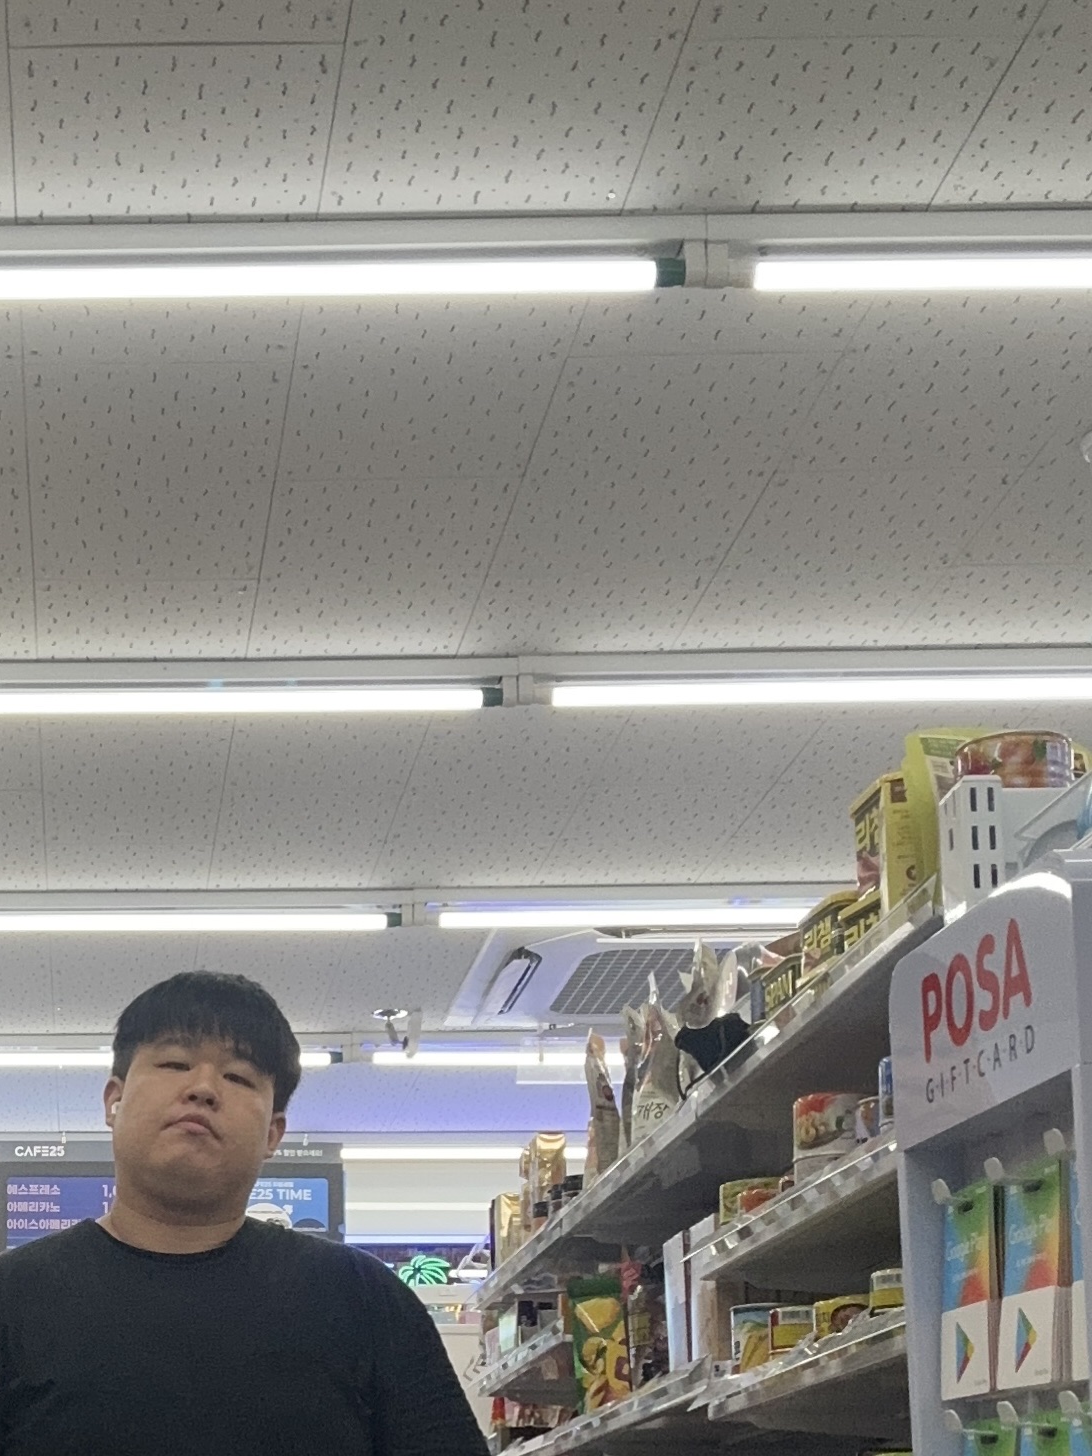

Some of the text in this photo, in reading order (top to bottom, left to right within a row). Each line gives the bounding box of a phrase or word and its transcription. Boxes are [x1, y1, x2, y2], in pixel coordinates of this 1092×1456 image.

[921, 917, 1033, 1064] POSA
[14, 1146, 65, 1157] CAFE25
[6, 1184, 61, 1195] 에스프레소
[249, 1189, 312, 1200] E25 TIME
[6, 1202, 61, 1213] 아메리카노
